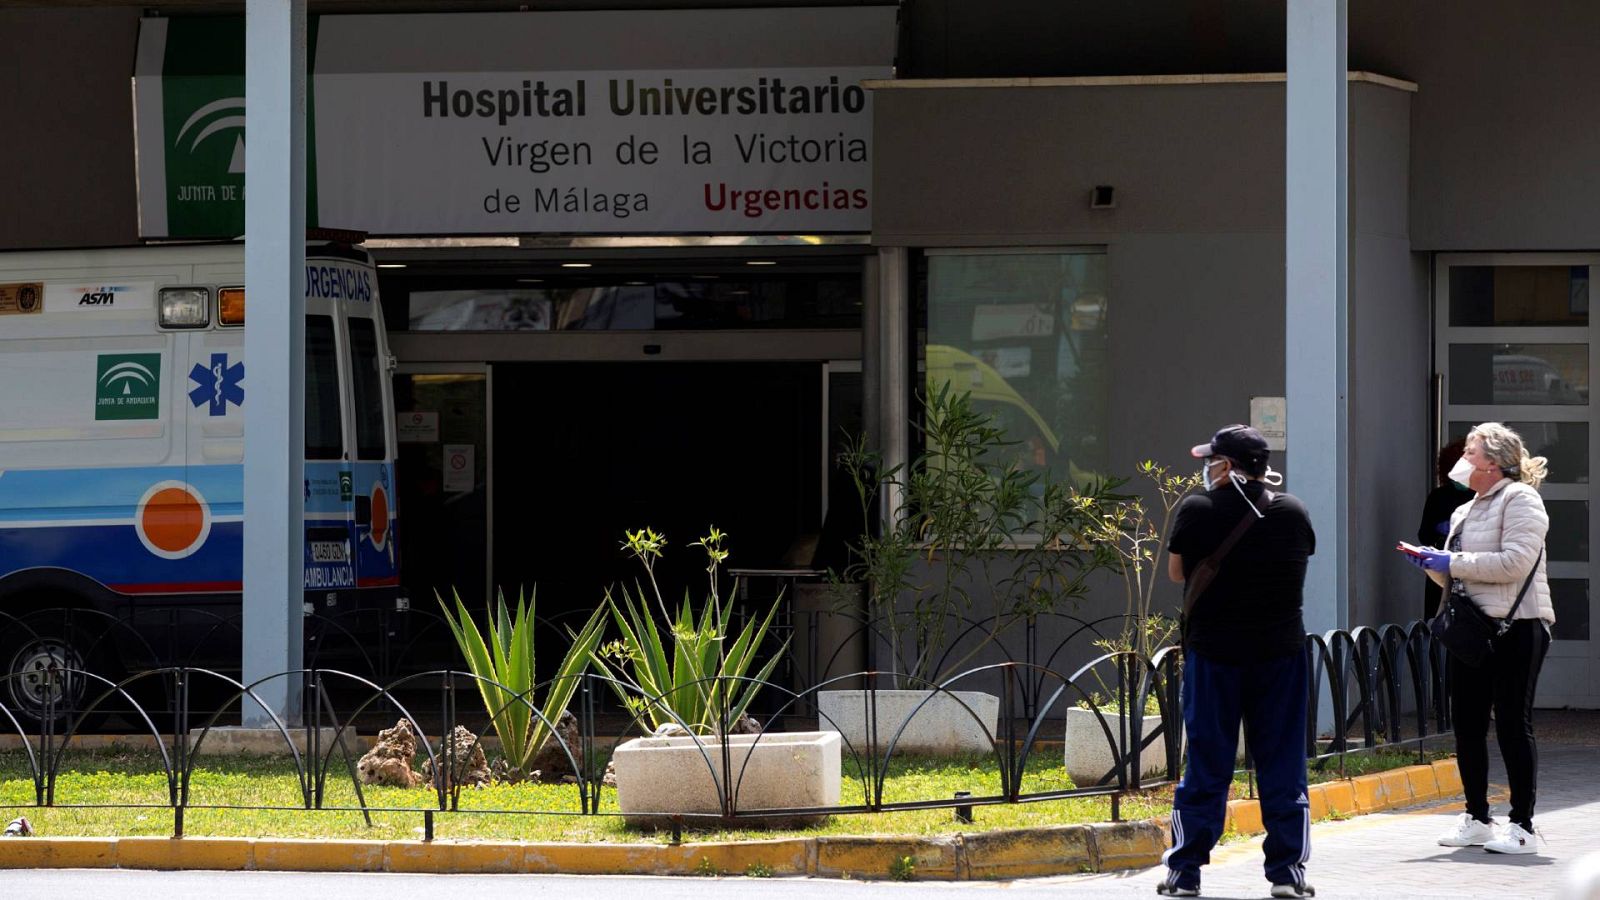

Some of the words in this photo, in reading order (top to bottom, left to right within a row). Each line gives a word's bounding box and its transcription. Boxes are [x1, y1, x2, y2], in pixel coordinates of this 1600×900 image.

[423, 80, 586, 126] Hospital
[609, 76, 865, 116] Universitario
[482, 136, 592, 173] Virgen
[616, 135, 659, 165] de
[683, 134, 712, 165] la
[735, 132, 867, 163] Victoria
[177, 185, 216, 201] JUNTA
[220, 185, 237, 201] DE
[483, 188, 521, 213] de
[534, 187, 649, 219] Málaga
[704, 181, 868, 218] Urgencias
[78, 292, 114, 305] ASM
[304, 566, 354, 587] AMBULANCIA
